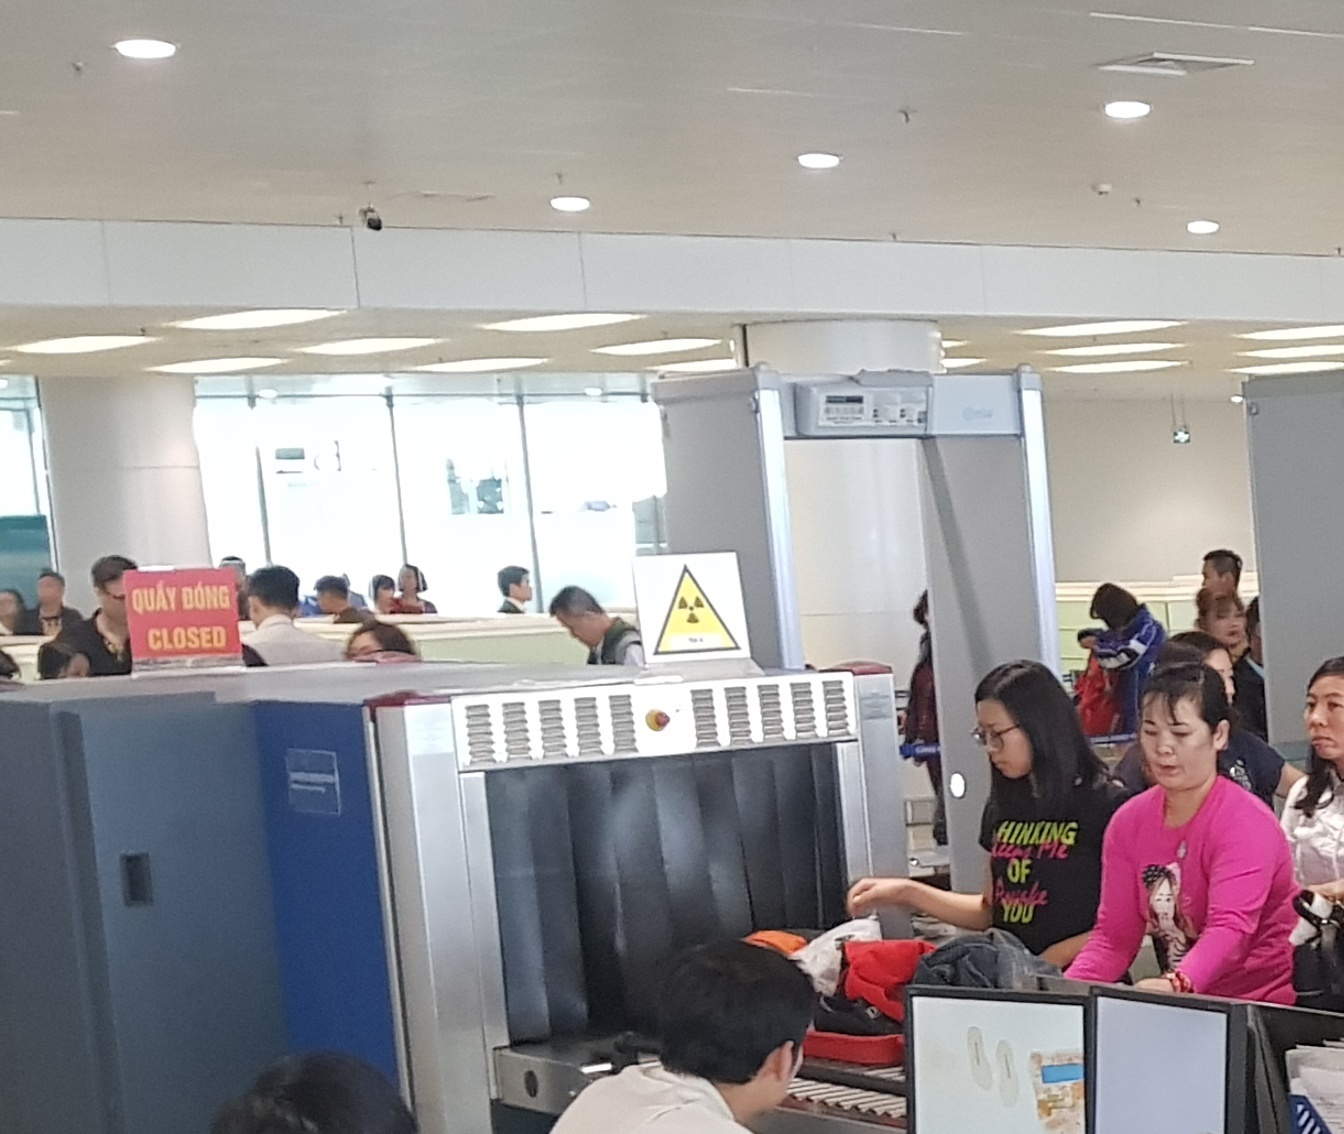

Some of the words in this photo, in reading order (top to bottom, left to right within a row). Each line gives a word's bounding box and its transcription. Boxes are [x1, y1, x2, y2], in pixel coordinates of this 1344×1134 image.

[147, 626, 227, 651] CLOSED
[1006, 858, 1033, 884] OF
[1001, 900, 1037, 924] YOU
